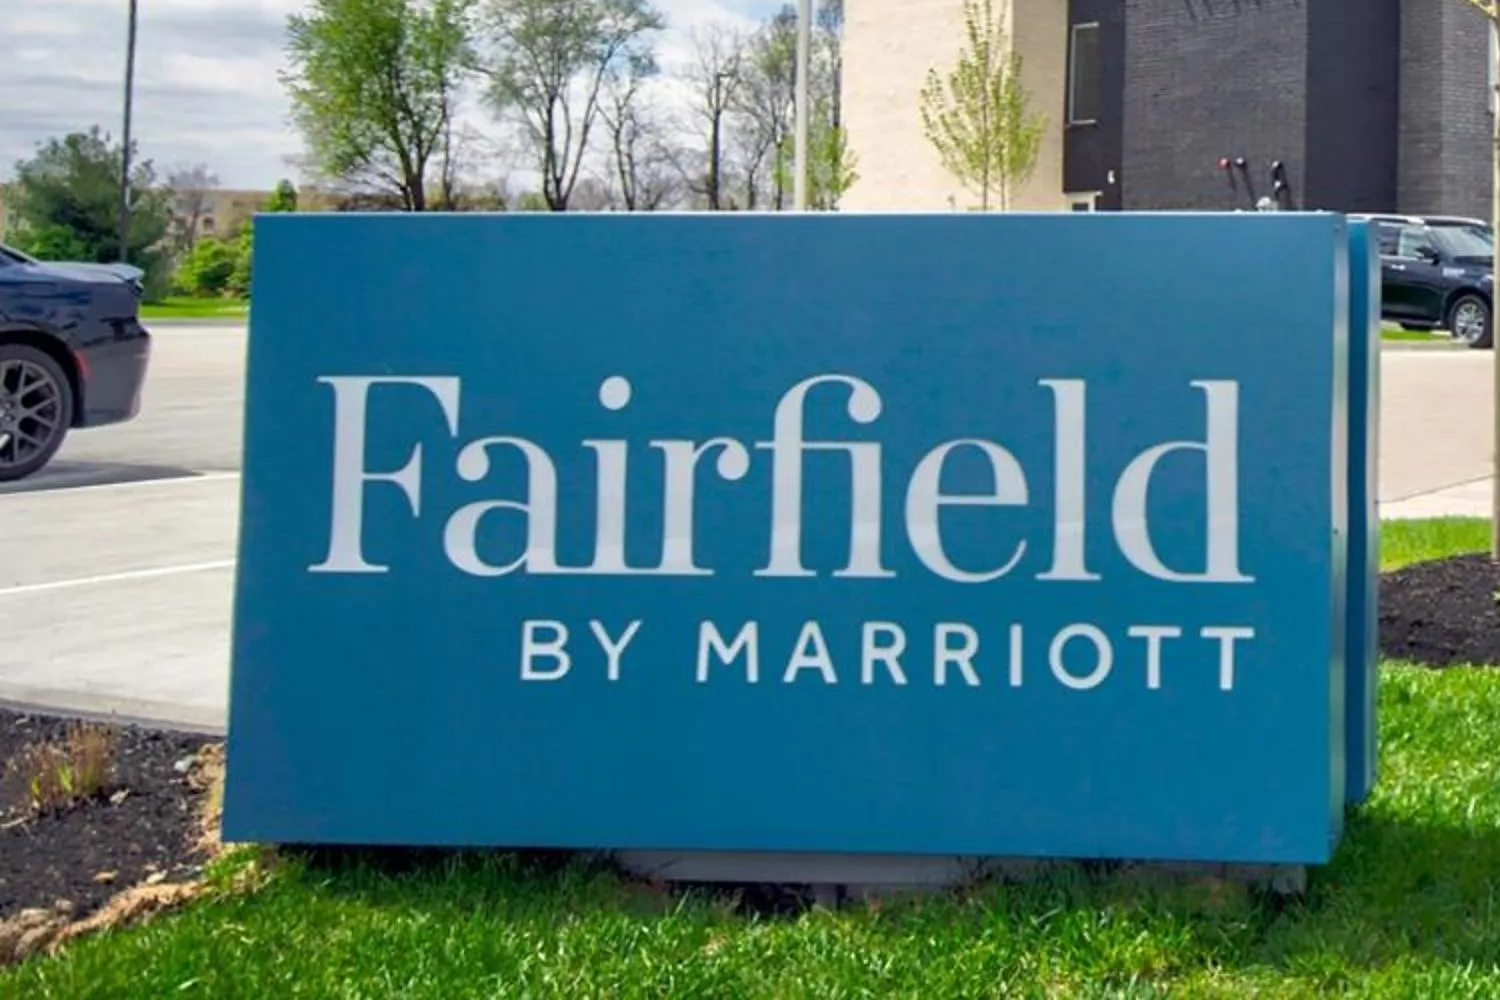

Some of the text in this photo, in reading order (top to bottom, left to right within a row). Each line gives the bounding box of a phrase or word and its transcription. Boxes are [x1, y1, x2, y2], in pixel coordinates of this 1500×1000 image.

[308, 374, 1256, 583] Fairfield
[521, 620, 1255, 690] BY MARRIOTT
